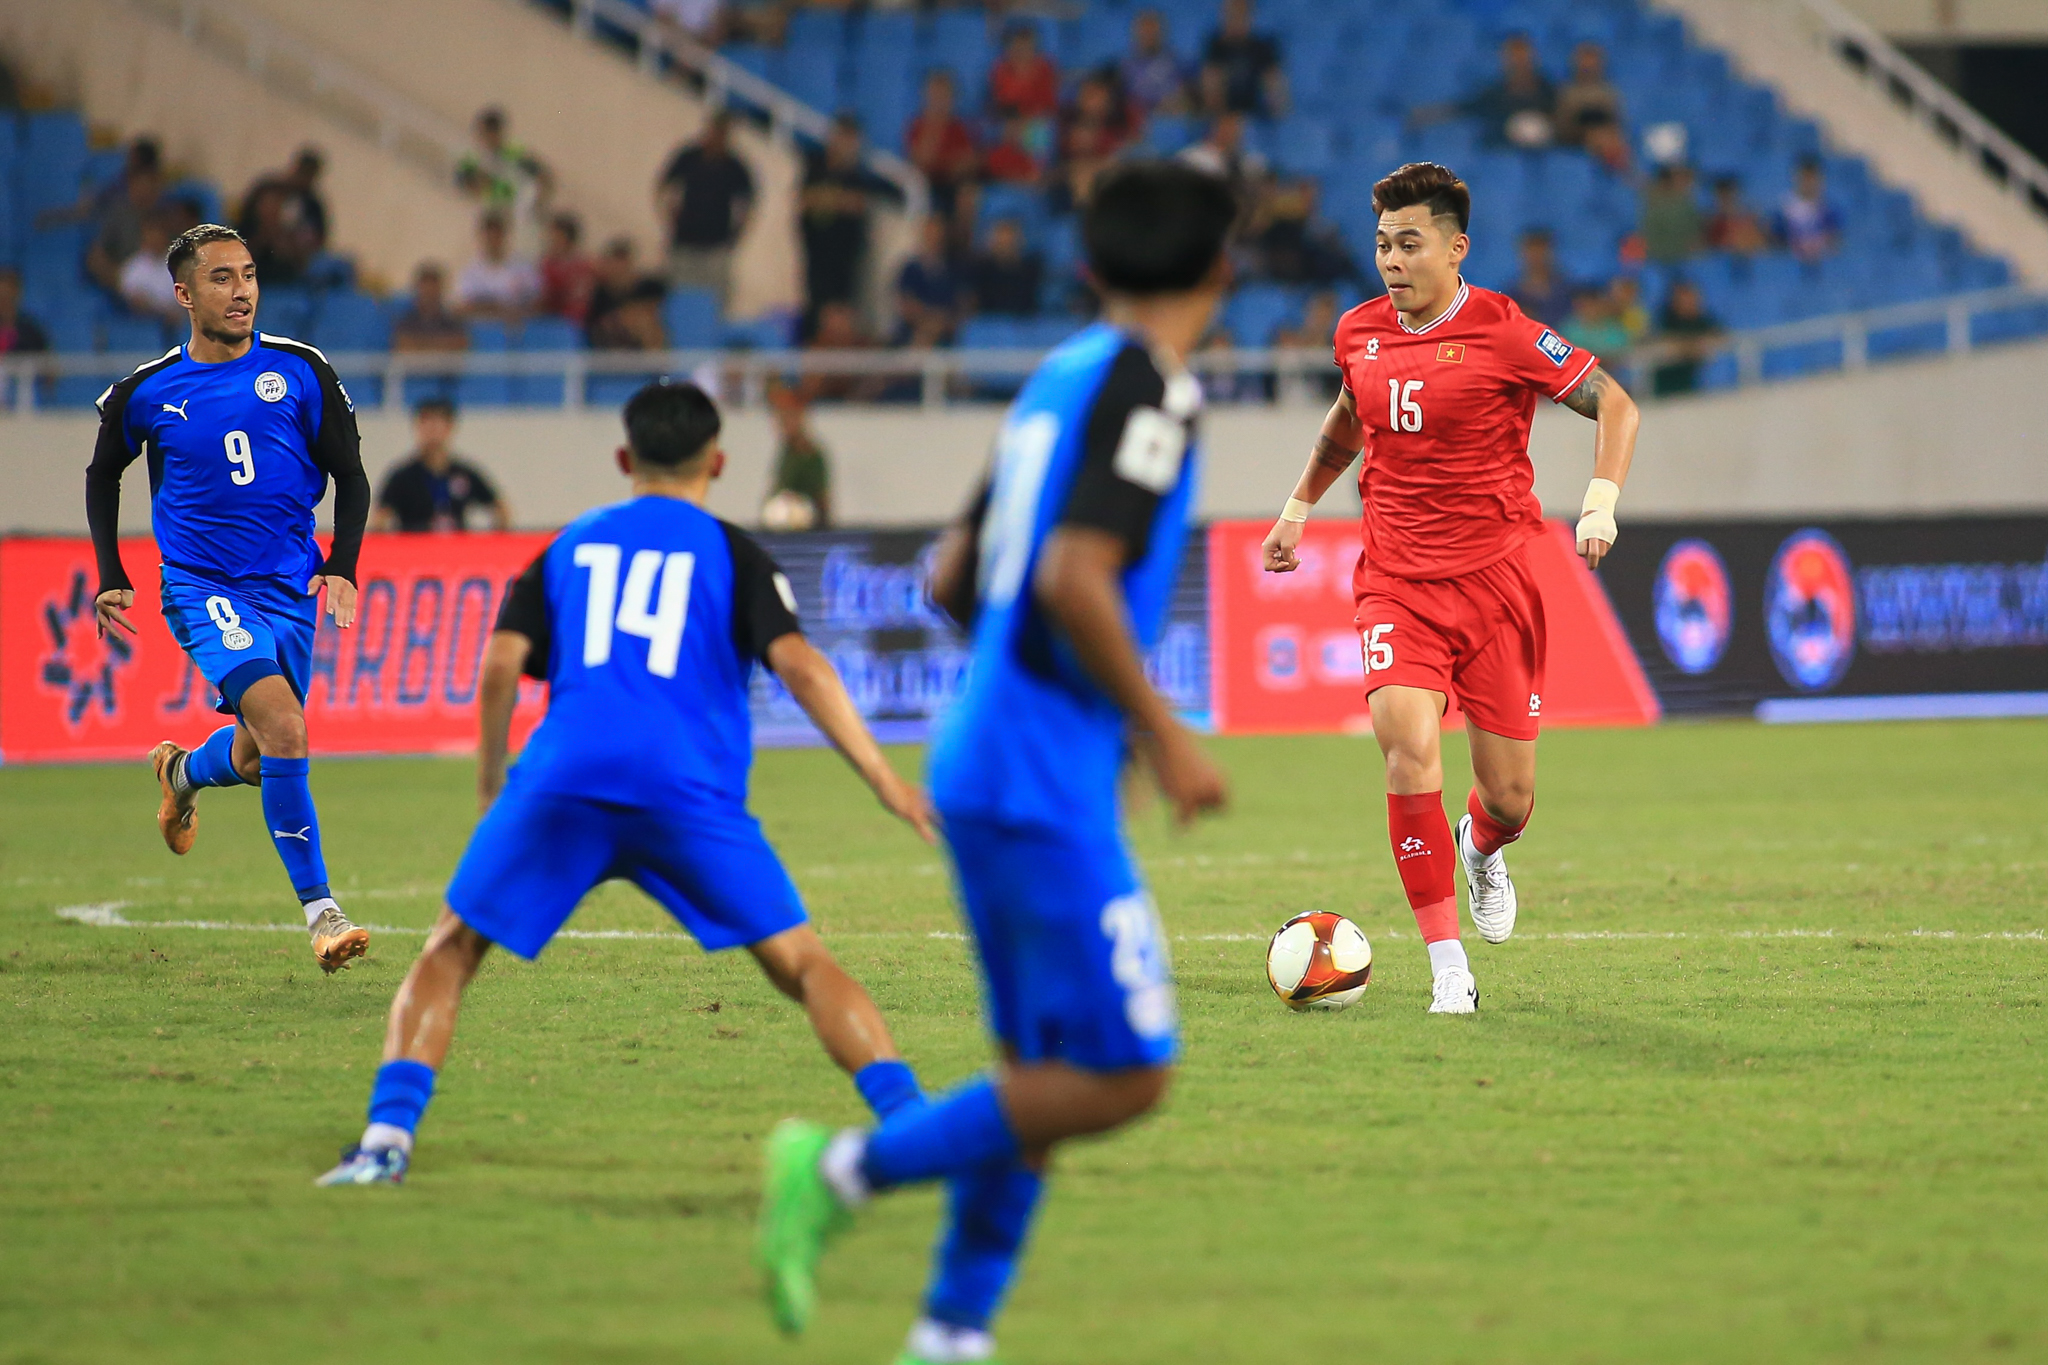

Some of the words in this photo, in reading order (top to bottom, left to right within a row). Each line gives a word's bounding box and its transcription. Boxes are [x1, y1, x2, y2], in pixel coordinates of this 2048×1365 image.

[1388, 378, 1424, 433] 15
[224, 430, 255, 485] 9
[573, 543, 696, 679] 14
[1362, 623, 1395, 675] 15
